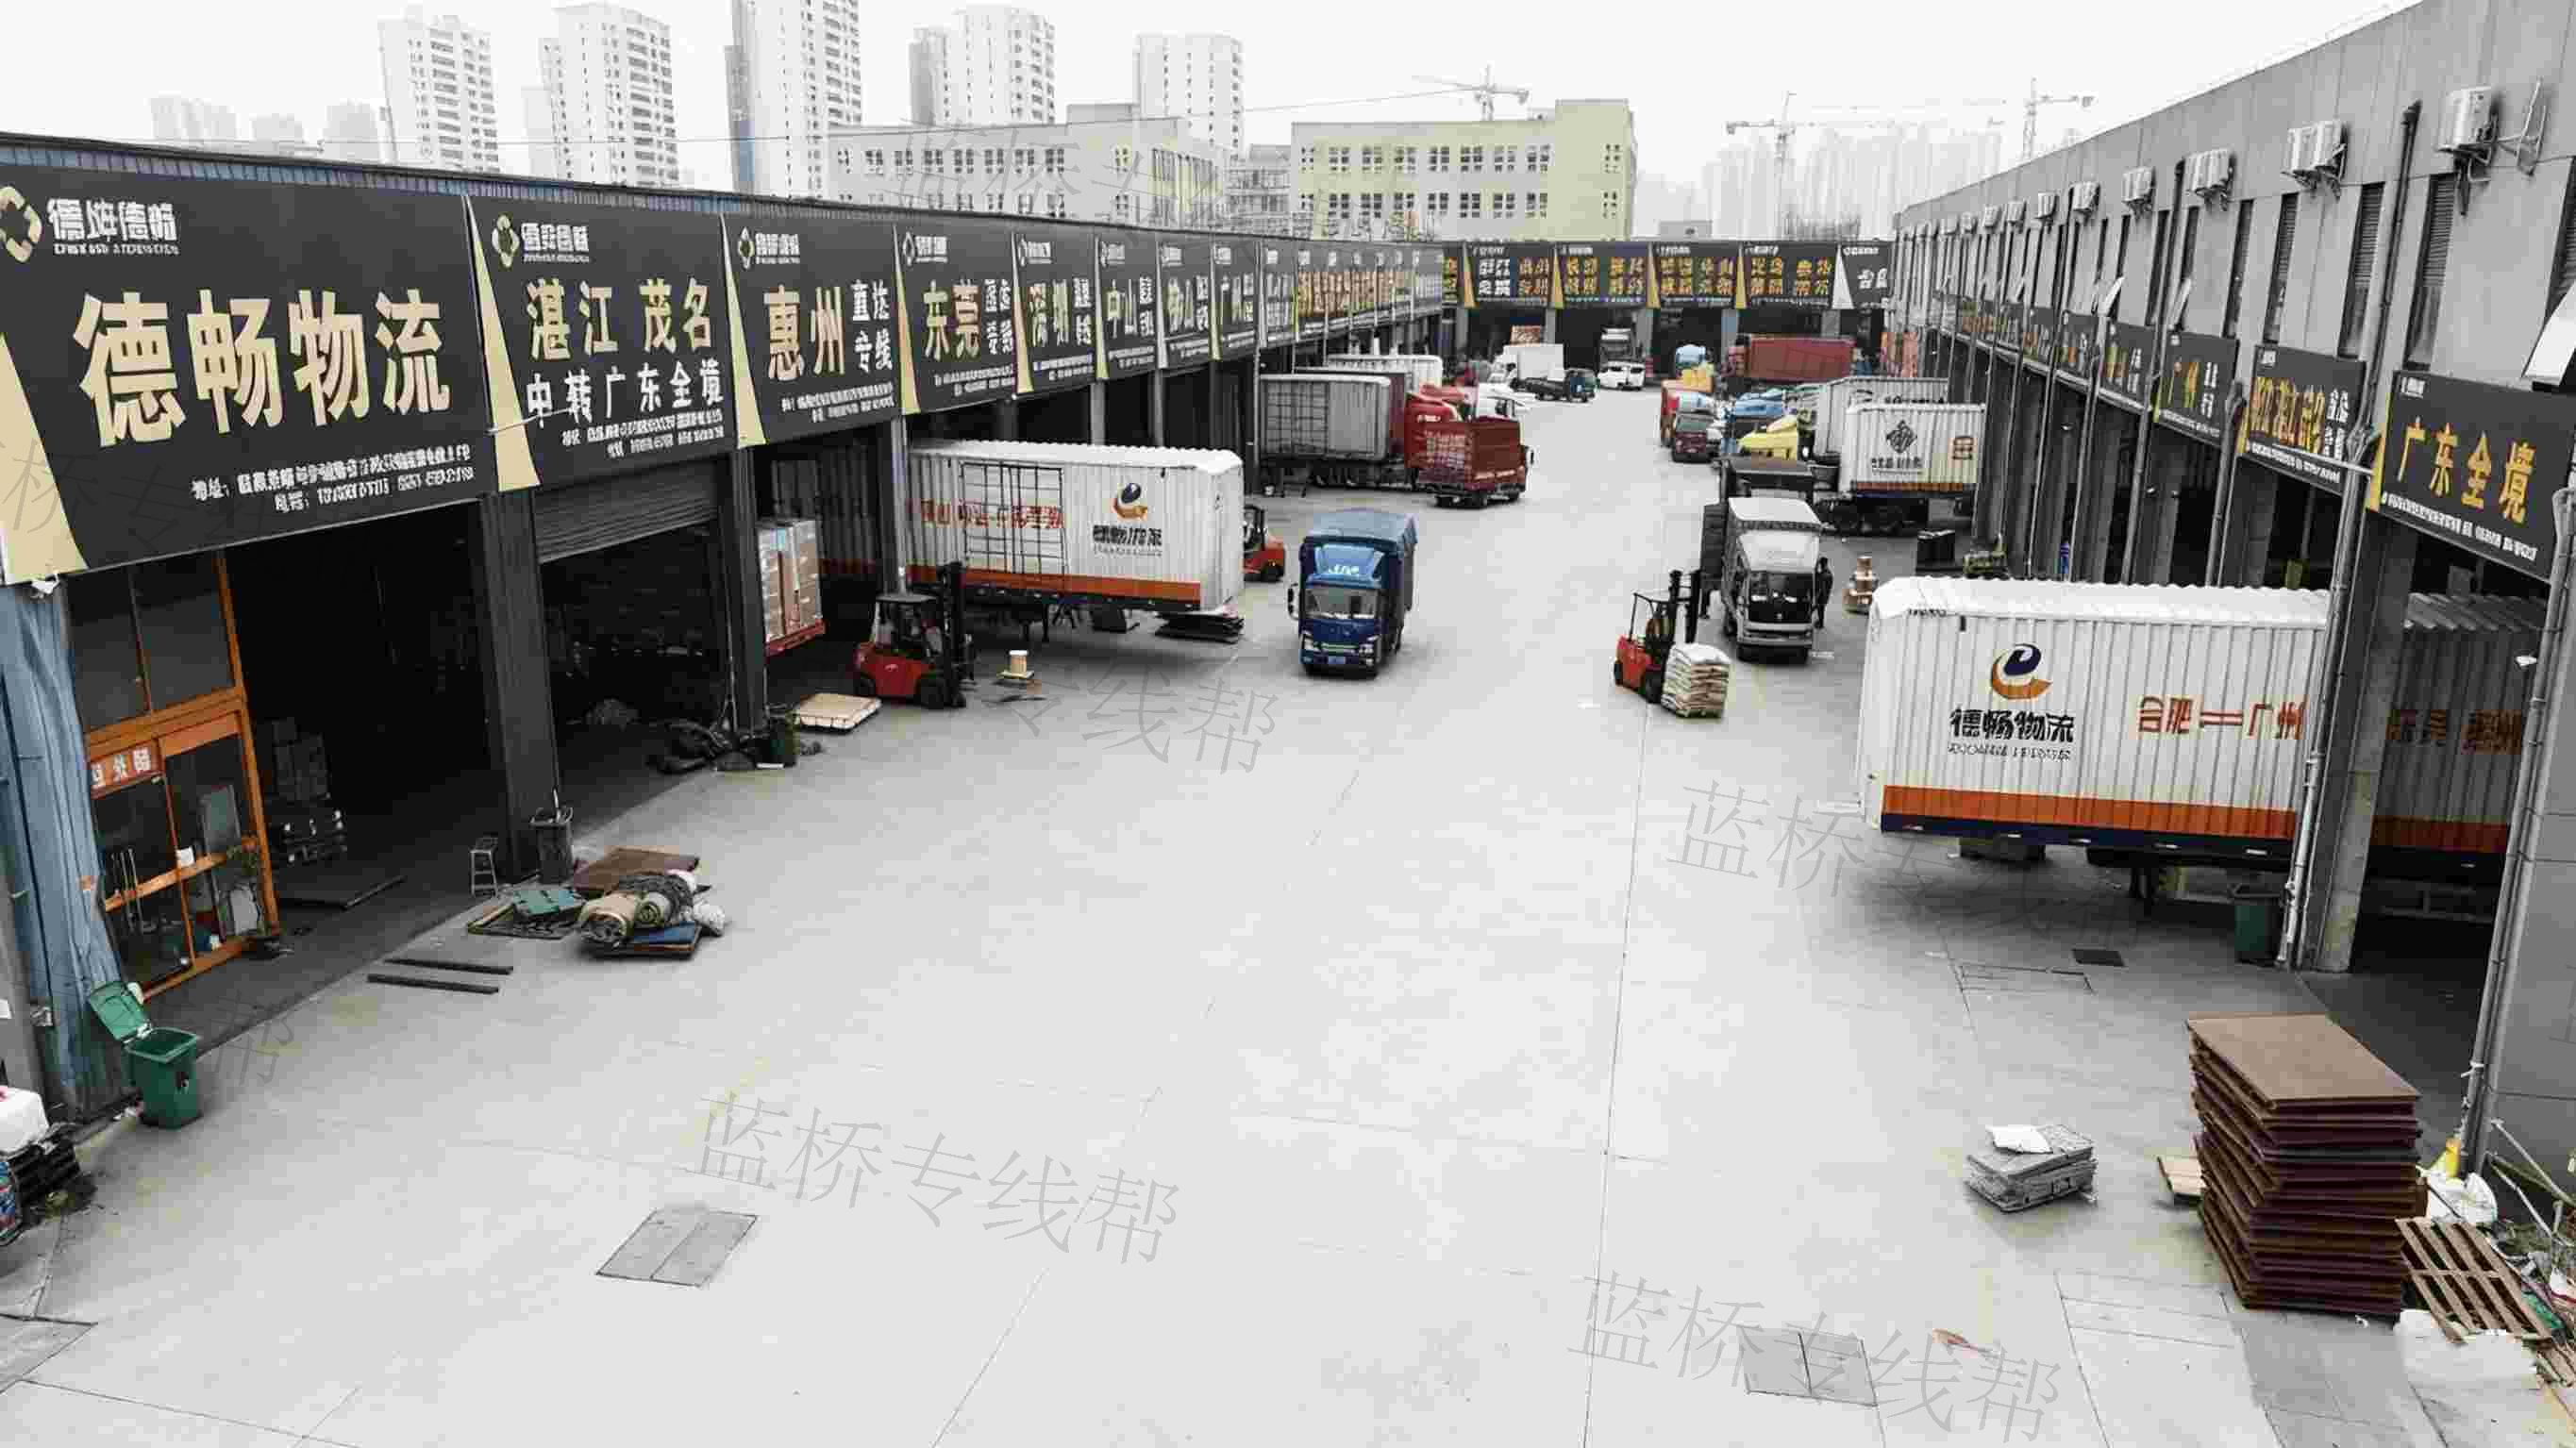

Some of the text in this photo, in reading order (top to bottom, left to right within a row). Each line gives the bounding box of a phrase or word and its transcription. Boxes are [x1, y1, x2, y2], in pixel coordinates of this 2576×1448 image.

[527, 277, 712, 361] 湛江 茂名
[764, 285, 845, 380] 惠州
[923, 278, 981, 361] 东莞
[73, 289, 450, 448] 德畅物流
[526, 358, 725, 427] 中转广东全境
[2397, 416, 2537, 524] 广东全境
[1949, 708, 2075, 743] 德畅物流
